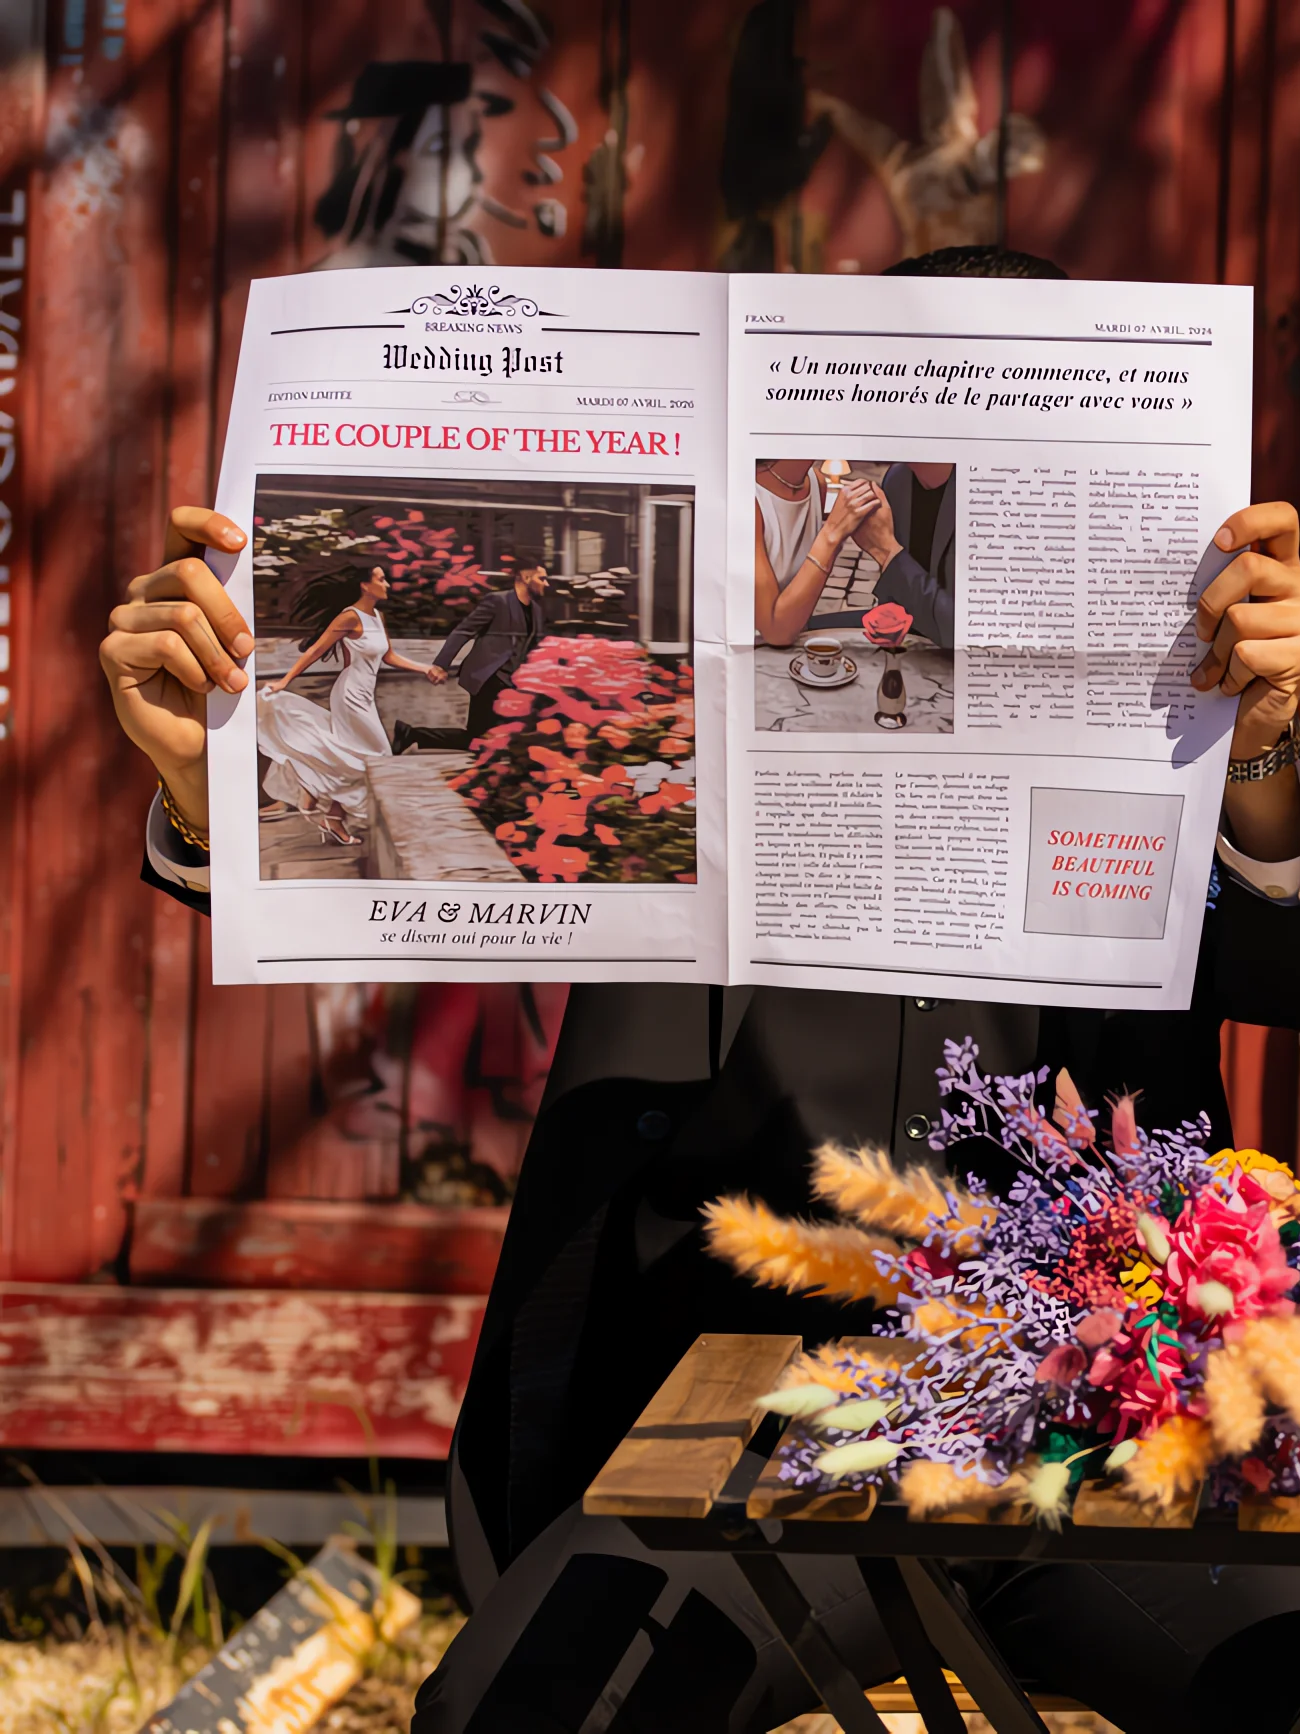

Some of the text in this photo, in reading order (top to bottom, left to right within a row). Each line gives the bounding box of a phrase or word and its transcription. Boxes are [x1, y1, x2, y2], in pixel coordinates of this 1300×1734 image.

[425, 322, 522, 334] BREAKING NEWS
[745, 314, 786, 323] FRANCE
[1095, 323, 1131, 333] MARDI
[1134, 324, 1146, 333] 07
[383, 344, 564, 378] Wedding Post
[790, 356, 819, 375] Un
[825, 361, 907, 377] nouveau
[913, 359, 995, 383] chapitre
[1001, 366, 1111, 384] commence,
[1118, 368, 1138, 383] et
[1143, 369, 1190, 384] nous
[576, 397, 614, 407] MARDI
[616, 398, 629, 407] 07
[765, 387, 845, 402] sommes
[851, 384, 929, 404] honorés
[935, 387, 958, 405] de
[964, 387, 982, 406] le
[985, 392, 1075, 412] partager
[1079, 395, 1125, 409] avec
[1131, 396, 1175, 410] vous
[269, 423, 330, 446] THE
[335, 423, 461, 450] COUPLE
[466, 426, 509, 451] OF
[513, 428, 581, 453] THE
[1047, 829, 1166, 852] SOMETHING
[1052, 855, 1155, 876] BEAUTIFUL
[1052, 880, 1153, 901] IS COMING
[368, 900, 593, 925] EVA & MARVIN
[380, 931, 397, 943] se
[401, 929, 447, 944] disent
[451, 931, 477, 944] oui
[480, 934, 517, 948] pour
[522, 931, 536, 945] la
[541, 932, 563, 945] vie
